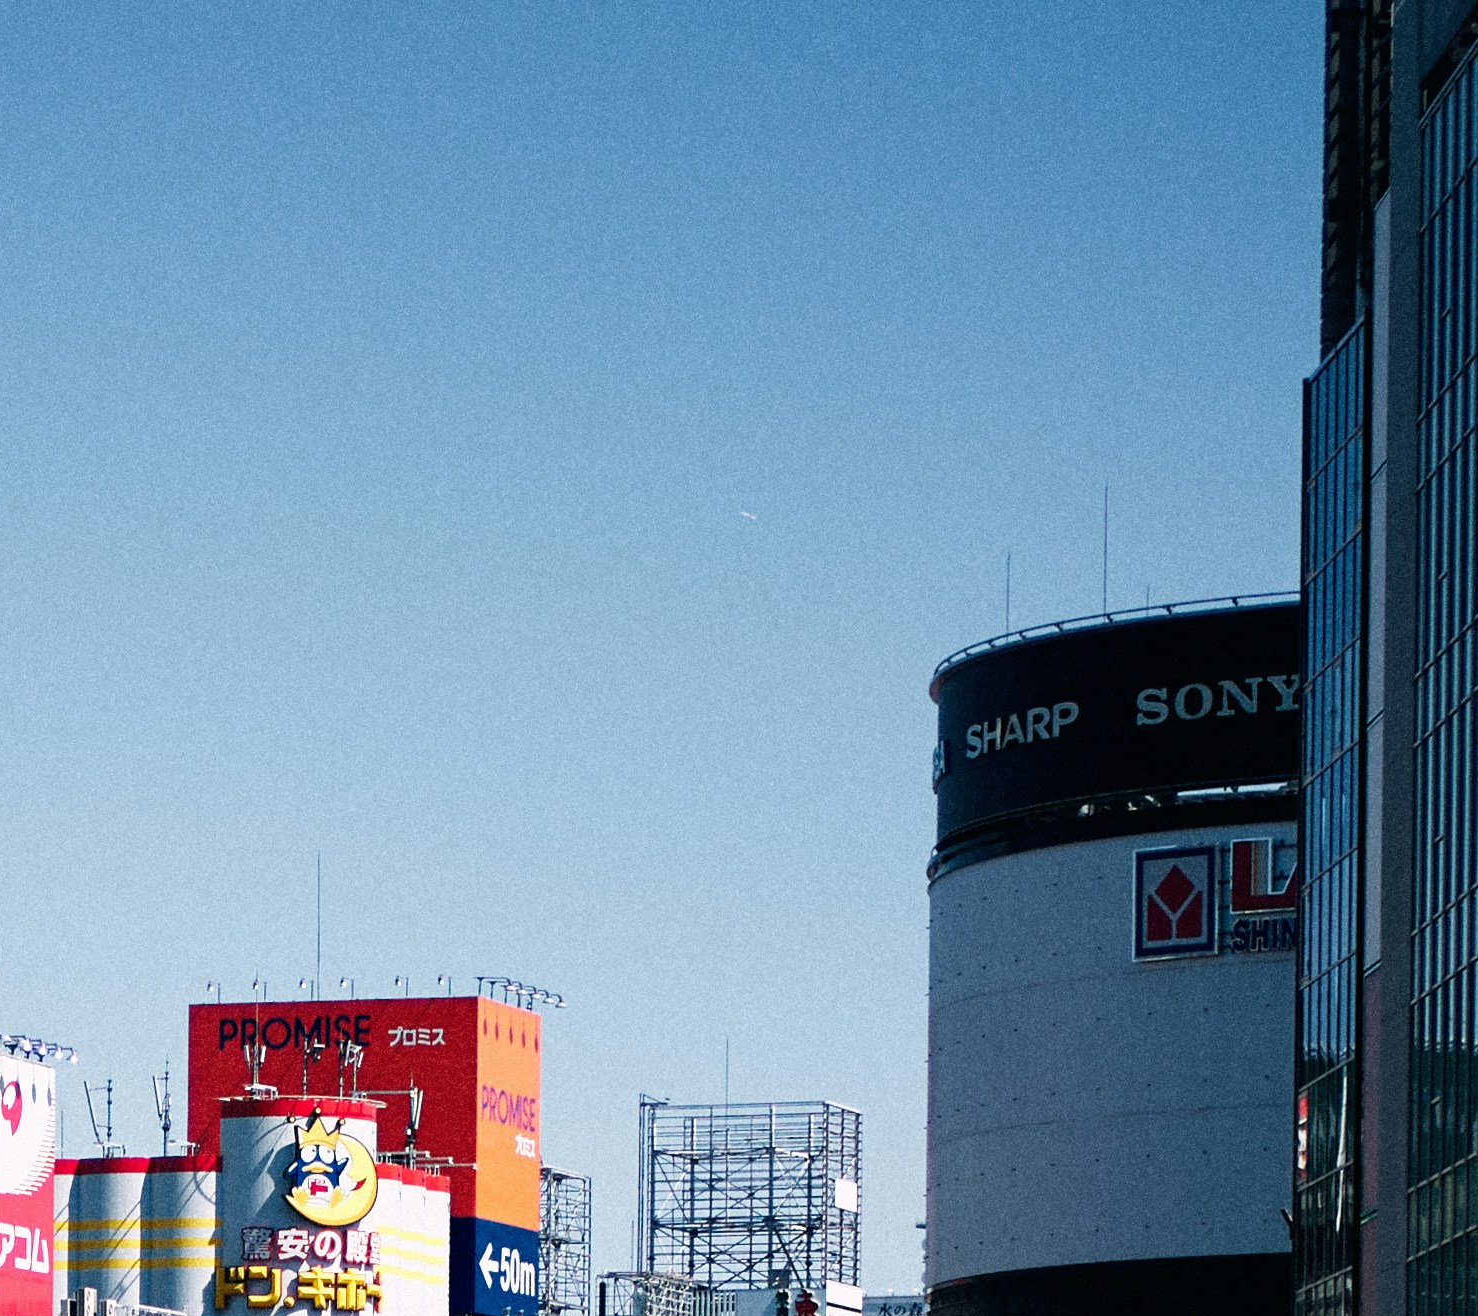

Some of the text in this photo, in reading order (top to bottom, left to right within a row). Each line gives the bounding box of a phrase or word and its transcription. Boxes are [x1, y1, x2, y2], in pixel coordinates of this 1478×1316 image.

[1135, 674, 1300, 727] SONY
[965, 701, 1079, 760] SHARP
[1230, 838, 1297, 913] L
[218, 1013, 446, 1051] PROMISE プロミス
[481, 1083, 537, 1134] PROMISE
[514, 1133, 537, 1160] プロミス
[499, 1247, 537, 1299] 50m
